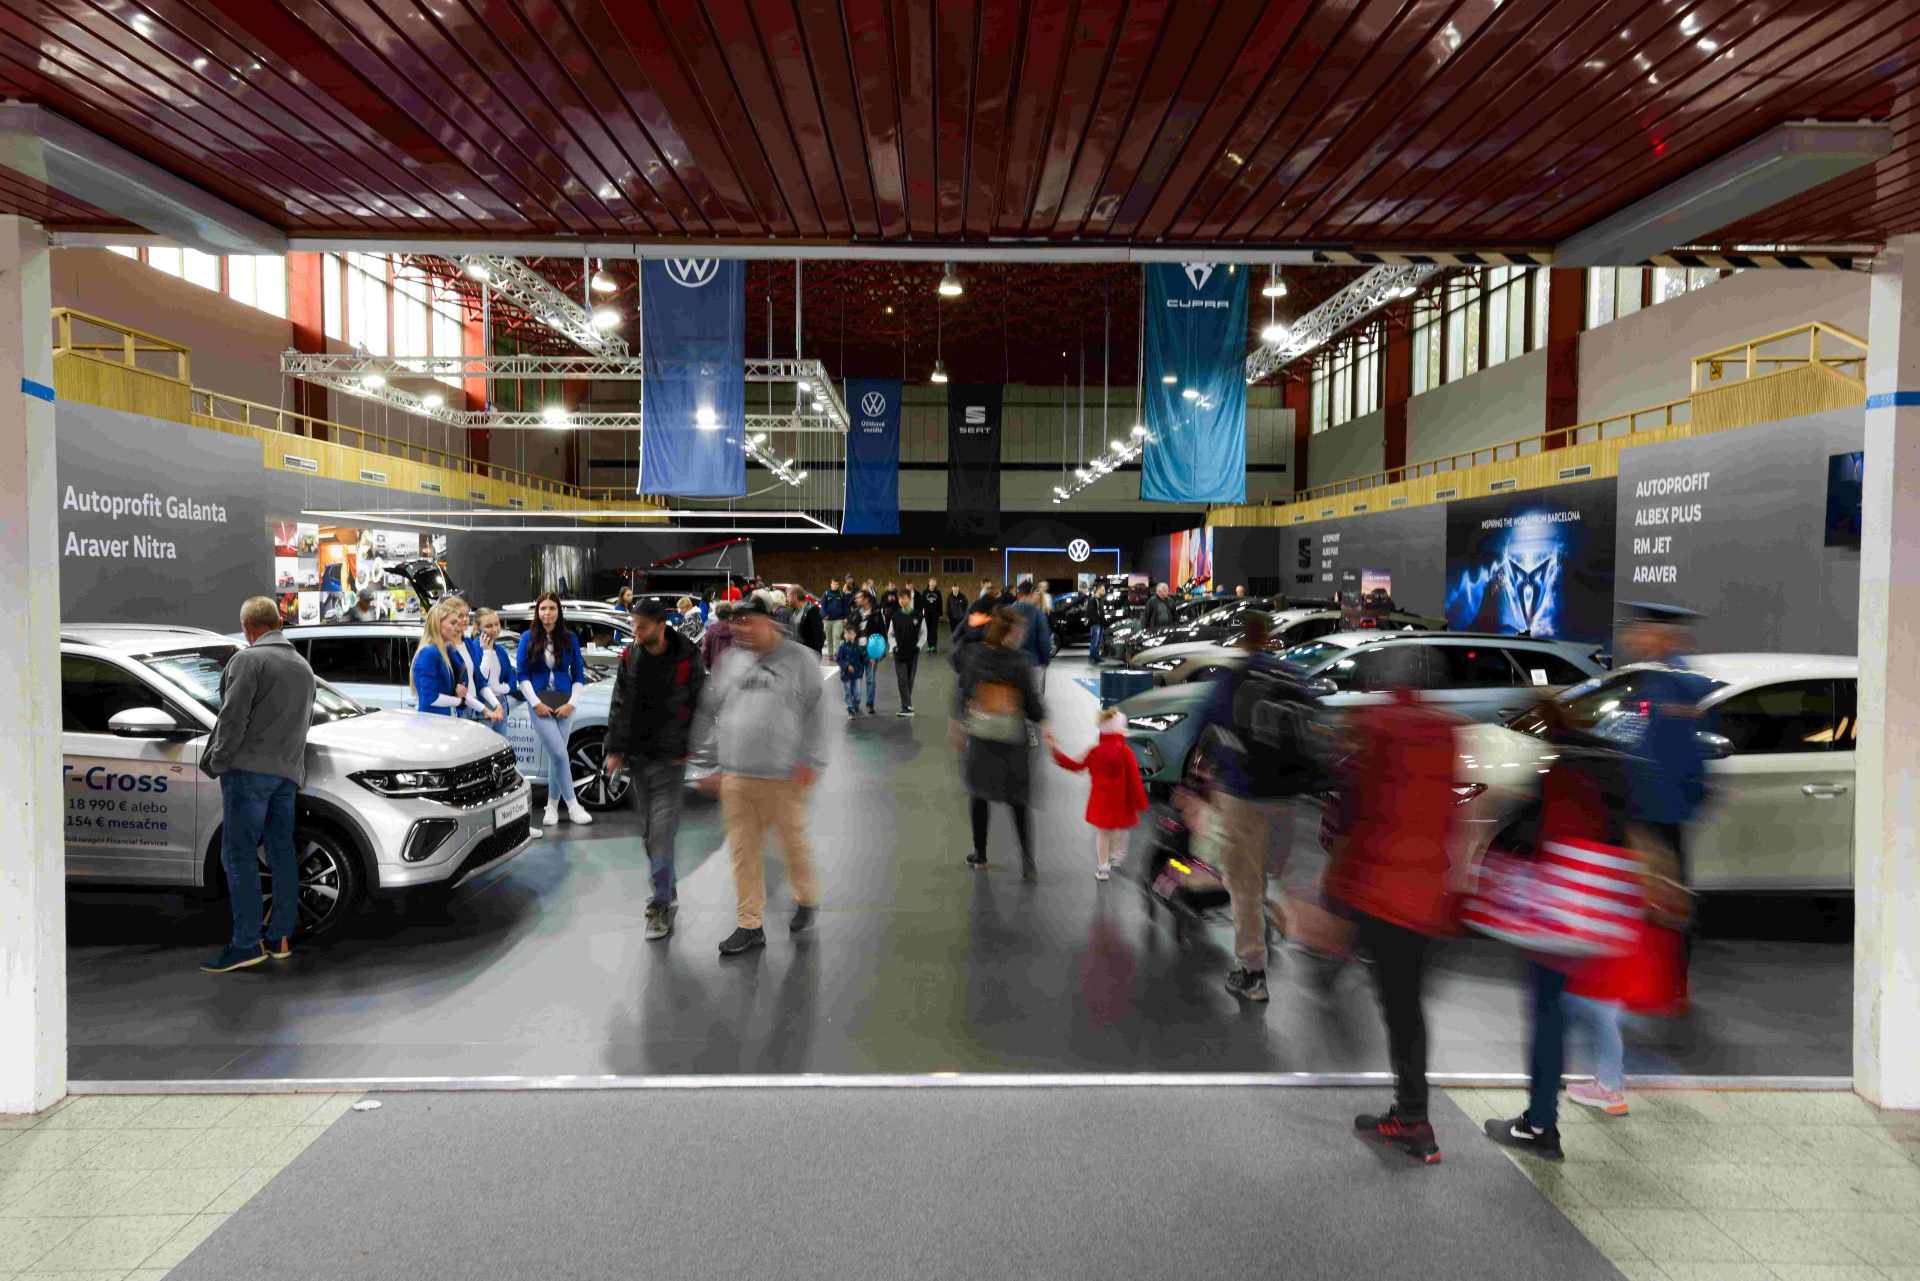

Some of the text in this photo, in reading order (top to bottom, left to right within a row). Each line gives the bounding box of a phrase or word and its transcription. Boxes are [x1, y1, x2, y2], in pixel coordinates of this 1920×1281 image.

[1166, 299, 1229, 309] CUPRA
[1636, 472, 1710, 498] AUTOPROFIT
[63, 485, 227, 522] Autoprofit Galanta
[1547, 510, 1581, 523] BARCELONA
[1635, 504, 1702, 526] ALBEX PLUS
[64, 531, 177, 560] Araver Nitra
[1068, 539, 1090, 562] VW
[1634, 536, 1672, 554] RM JET
[1633, 566, 1677, 582] ARAVER
[63, 765, 168, 793] T-Cross
[69, 799, 168, 814] 18 990 € alebo
[67, 816, 168, 830] 154 € mesačne
